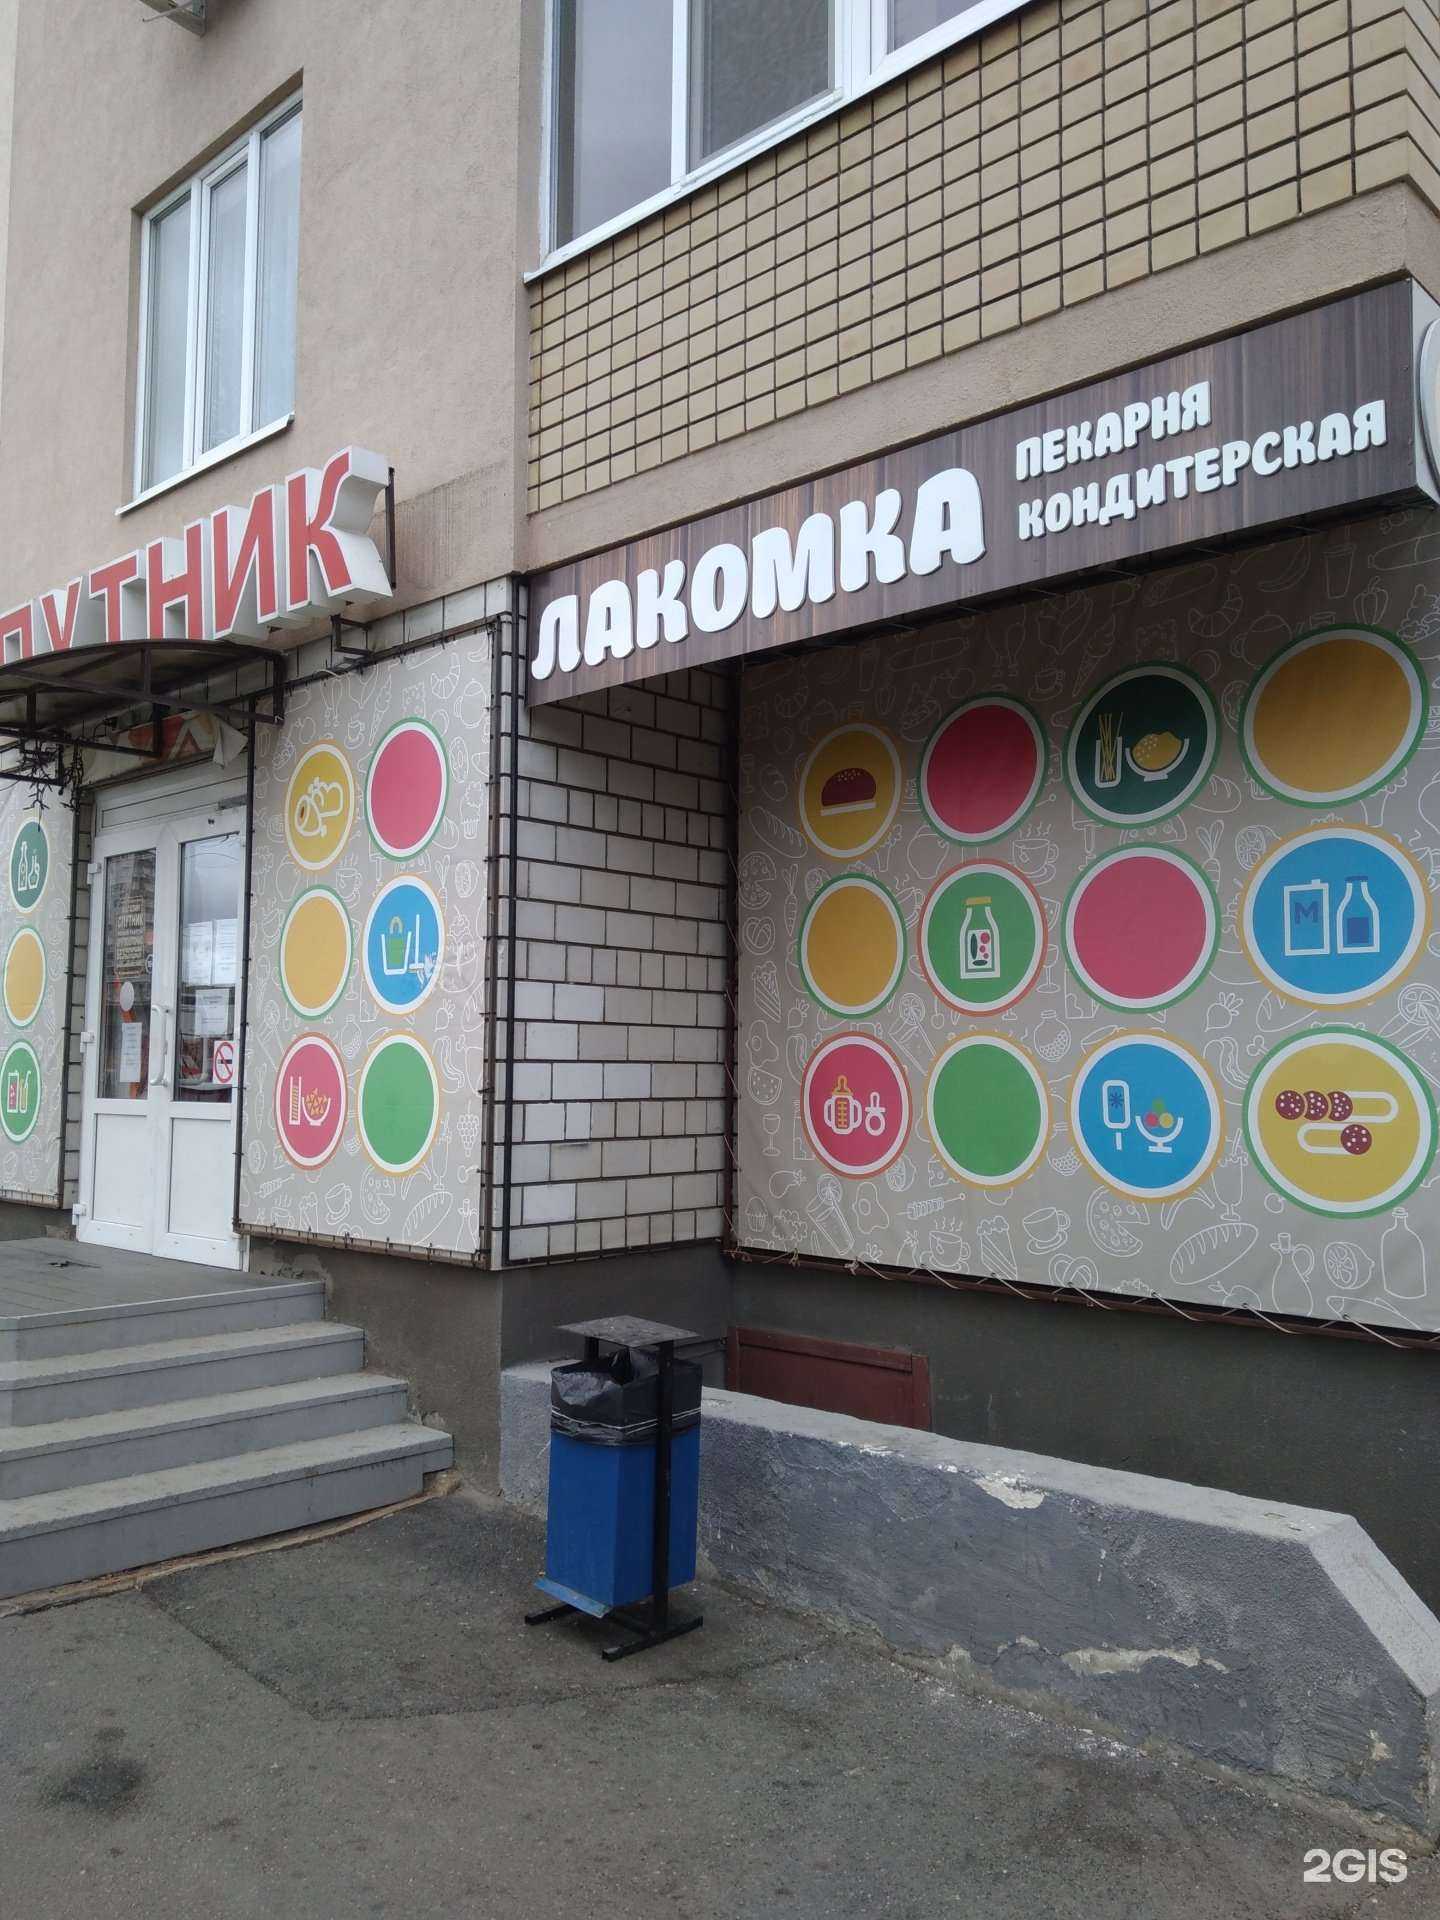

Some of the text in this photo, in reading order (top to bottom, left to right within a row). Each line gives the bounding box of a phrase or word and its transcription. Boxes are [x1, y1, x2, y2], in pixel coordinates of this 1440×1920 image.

[1015, 380, 1212, 481] ПЕКАРНЯ
[1018, 399, 1388, 541] КОНДИТЕРСКАЯ
[531, 467, 987, 681] ЛАКОМКА
